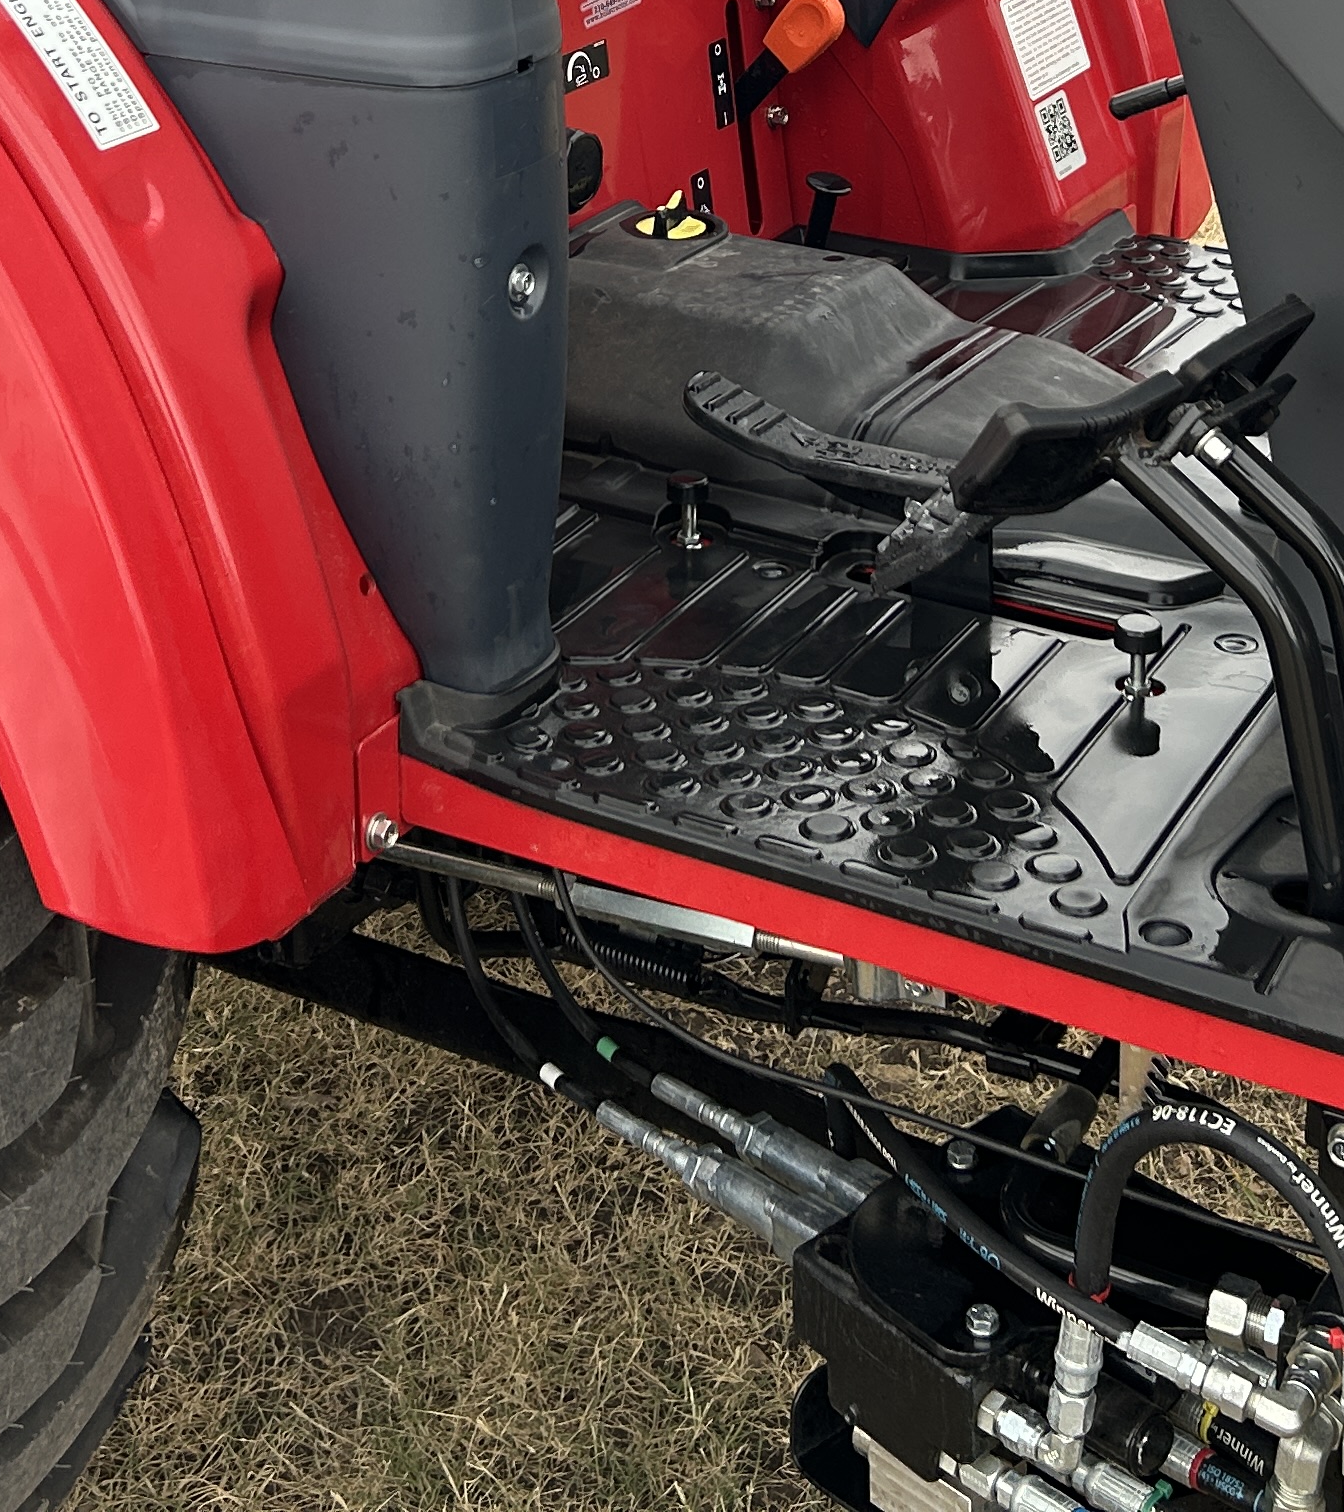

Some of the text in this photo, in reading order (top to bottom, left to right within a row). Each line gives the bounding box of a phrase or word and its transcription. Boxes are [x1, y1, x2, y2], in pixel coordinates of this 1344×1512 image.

[53, 14, 65, 24] to
[42, 44, 89, 102] START
[83, 59, 113, 94] RANGE
[85, 76, 105, 97] PTO
[85, 110, 110, 135] TO
[1152, 1104, 1237, 1136] EC118-06
[1216, 1427, 1266, 1478] Winner
[1205, 1463, 1222, 1480] ISO
